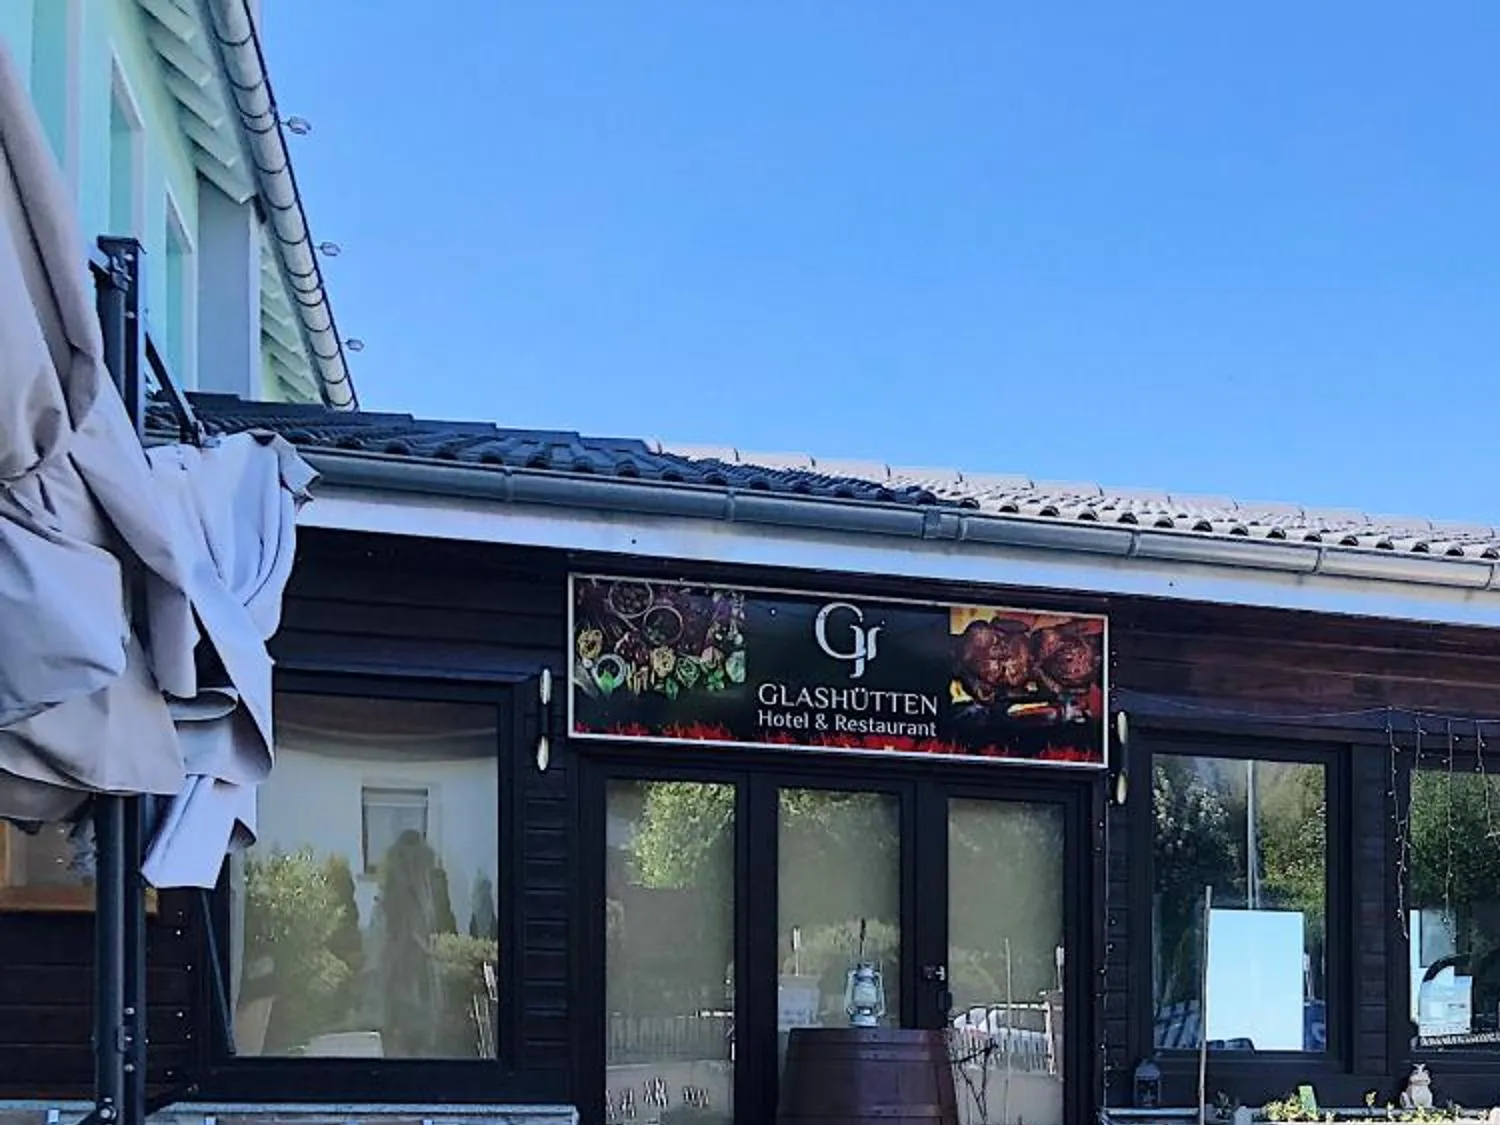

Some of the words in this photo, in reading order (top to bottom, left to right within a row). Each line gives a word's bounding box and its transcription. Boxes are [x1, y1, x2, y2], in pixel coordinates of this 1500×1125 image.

[758, 683, 938, 716] GLASHÜTTEN
[758, 710, 809, 729] Hotel
[815, 713, 829, 730] &
[835, 714, 937, 737] Restaurant
